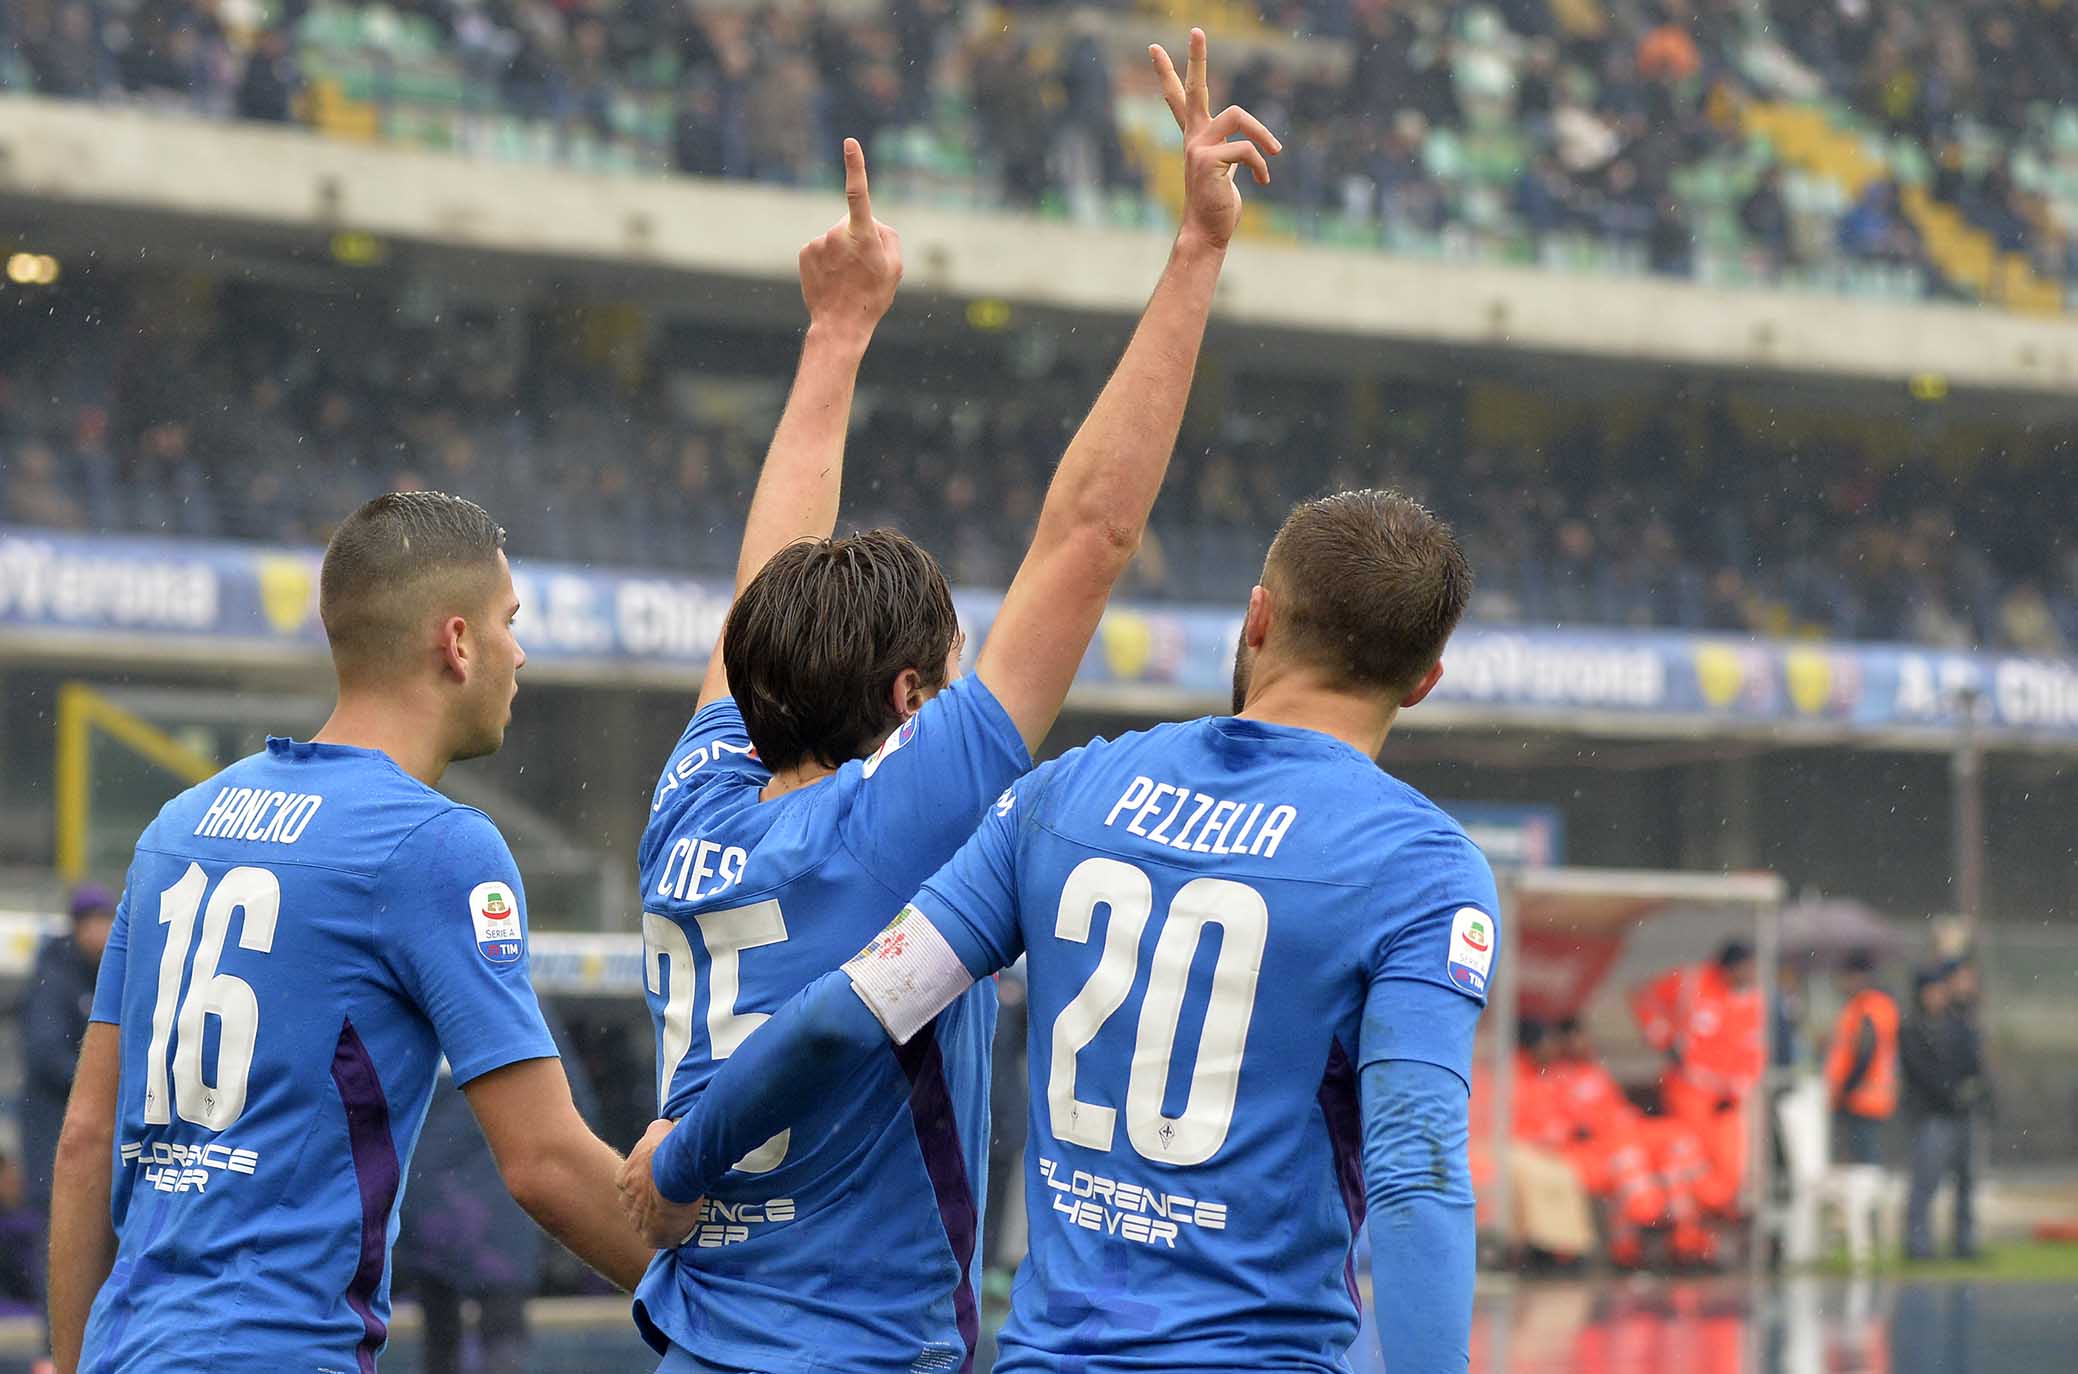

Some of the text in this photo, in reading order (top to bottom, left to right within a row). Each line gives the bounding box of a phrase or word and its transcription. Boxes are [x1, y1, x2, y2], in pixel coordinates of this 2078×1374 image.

[194, 787, 323, 844] HANCKO
[1104, 776, 1297, 858] PEZZELLA
[485, 929, 515, 939] SERIE A
[500, 943, 518, 955] TIM
[144, 862, 281, 1131] 16
[1048, 857, 1268, 1166] 20
[697, 1198, 795, 1222] ENCE
[1053, 1194, 1178, 1249] 4EVER
